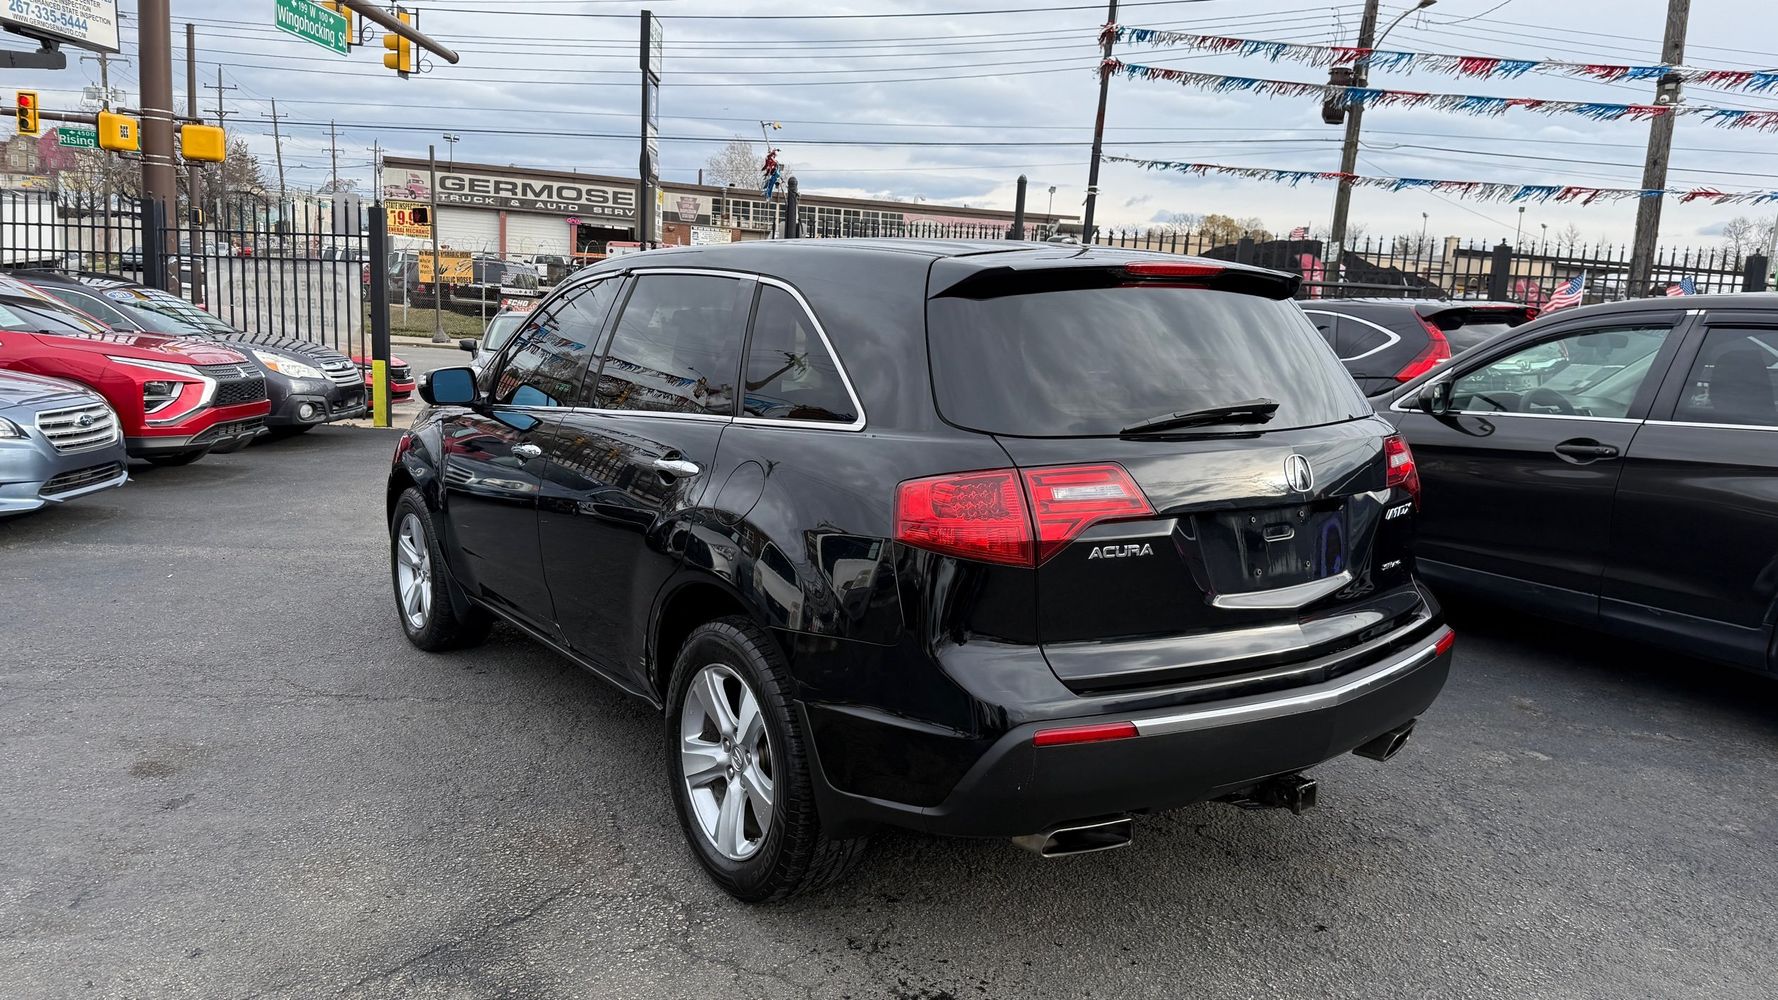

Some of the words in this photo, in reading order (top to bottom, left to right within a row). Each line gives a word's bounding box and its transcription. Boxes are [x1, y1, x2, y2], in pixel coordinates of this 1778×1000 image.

[8, 0, 89, 32] 267-335-5444
[61, 5, 80, 17] STATE
[79, 11, 112, 26] INSPECTION
[309, 4, 317, 19] W
[277, 4, 335, 48] Wingohocking
[338, 31, 346, 49] St
[59, 134, 95, 148] Rising
[438, 175, 634, 207] GERMOSE
[439, 193, 495, 205] TRUCK
[510, 199, 520, 207] &
[535, 201, 579, 212] AUTO
[593, 206, 635, 217] SERV
[1088, 543, 1154, 560] ACURA
